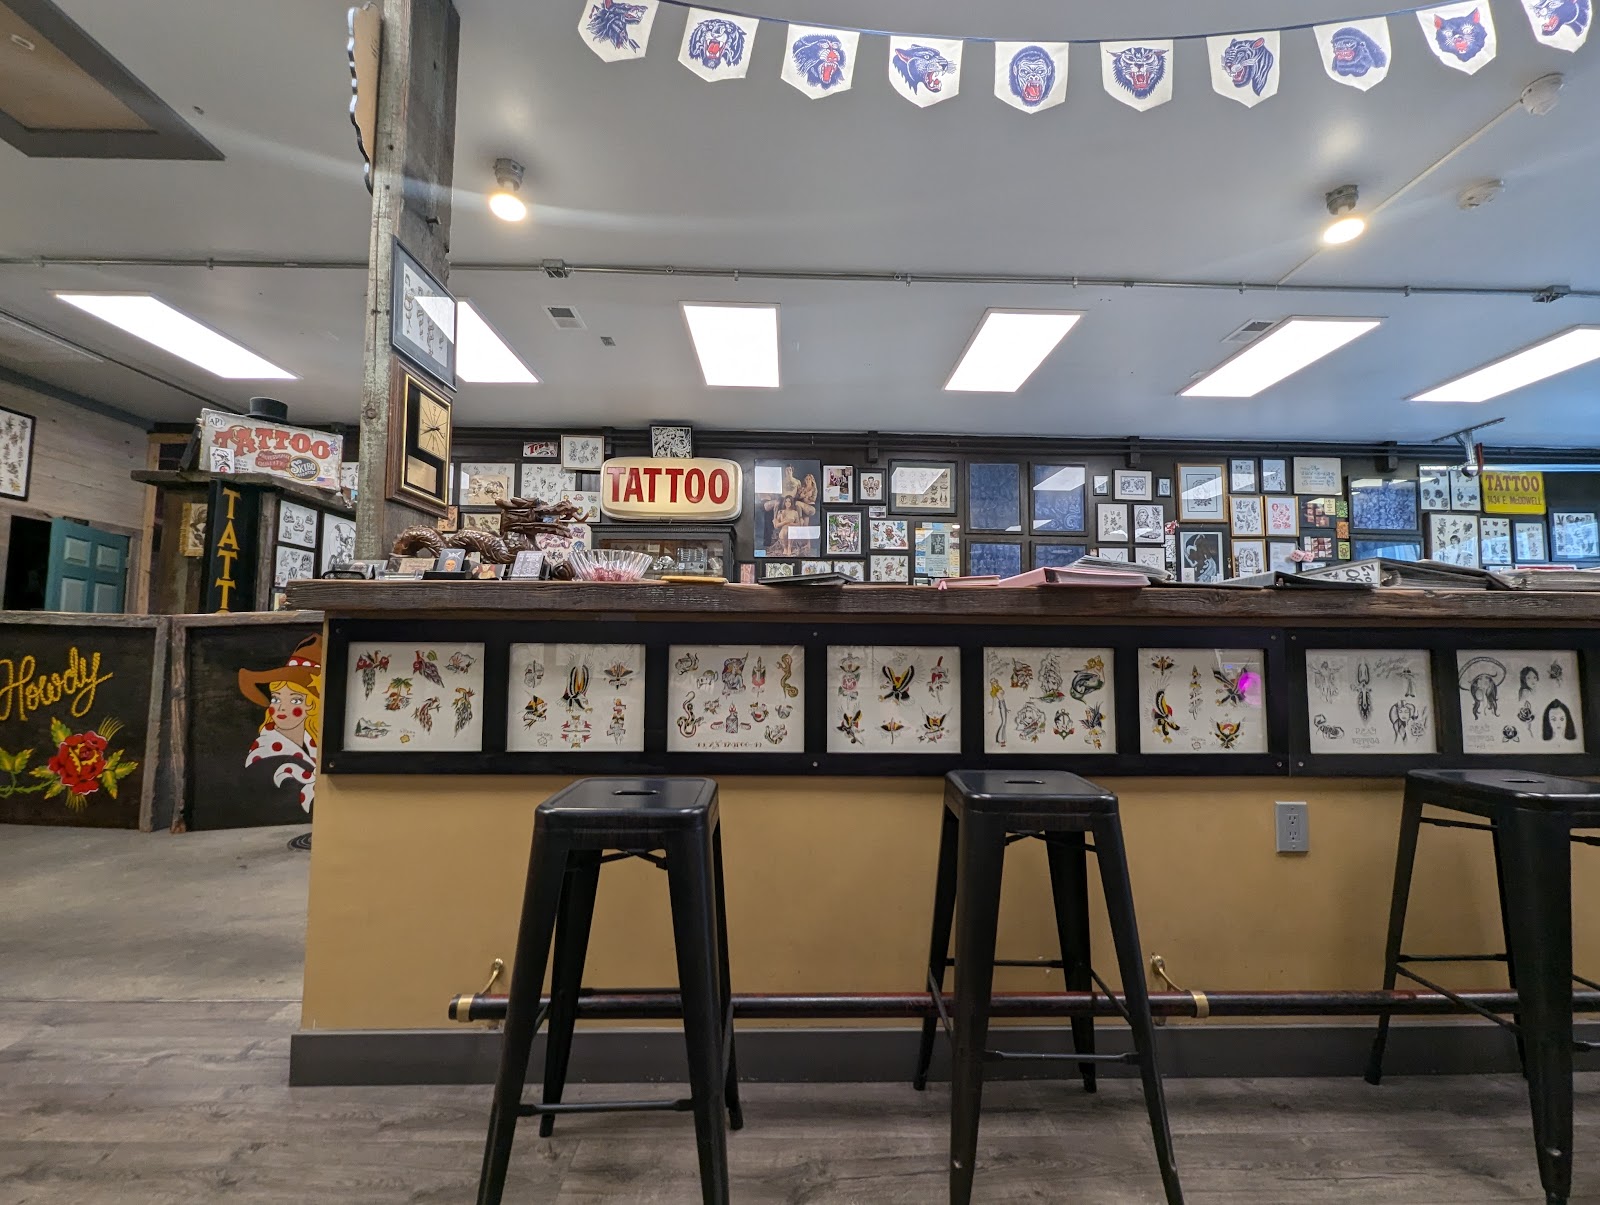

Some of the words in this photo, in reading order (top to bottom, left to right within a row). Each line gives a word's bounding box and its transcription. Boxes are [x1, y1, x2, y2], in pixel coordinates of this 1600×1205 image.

[213, 426, 331, 460] TATTOO
[291, 460, 316, 474] SKIBO
[1485, 475, 1540, 492] TATTOO
[606, 467, 730, 504] TATTOO
[215, 488, 240, 613] TATT
[0, 647, 113, 721] Howdy
